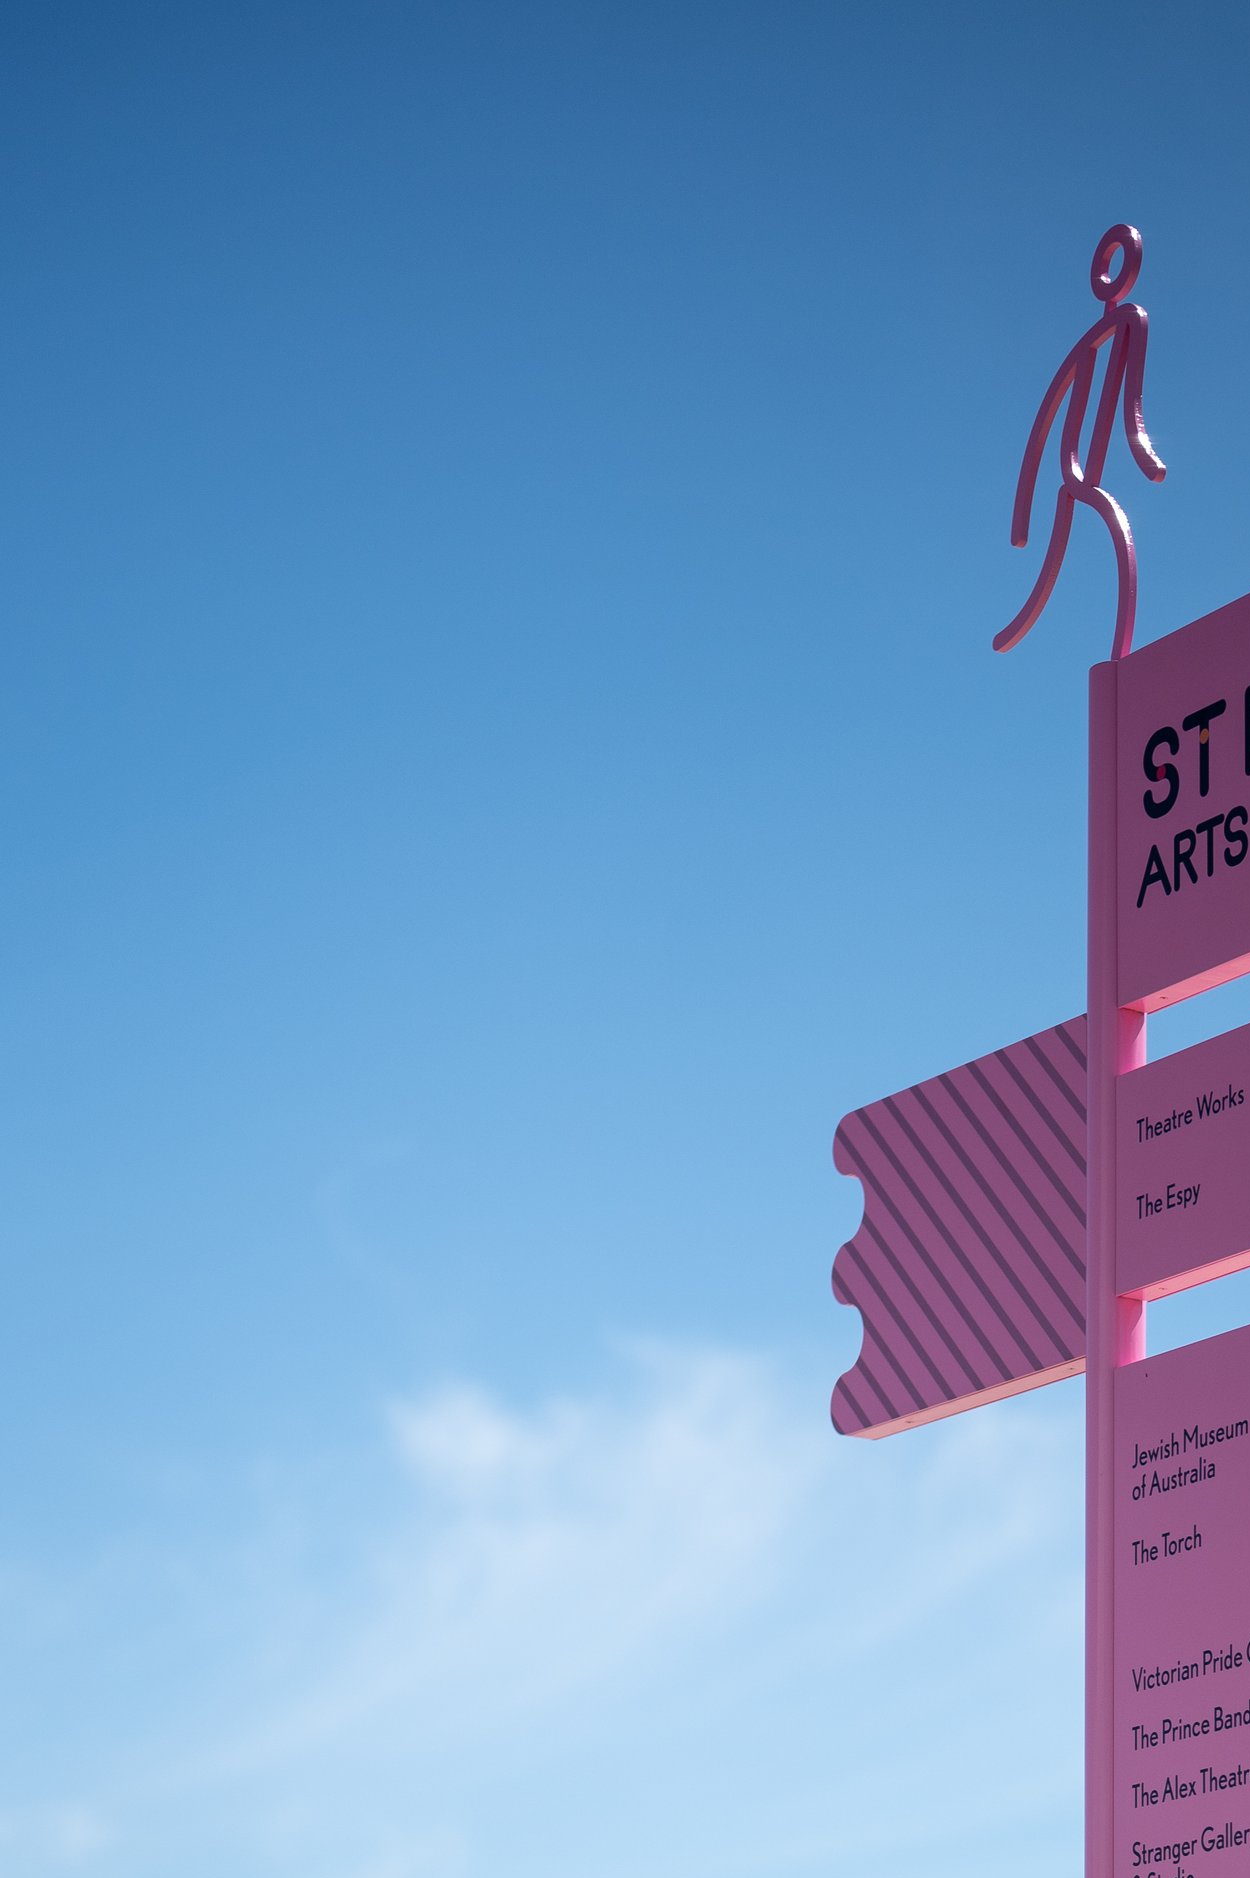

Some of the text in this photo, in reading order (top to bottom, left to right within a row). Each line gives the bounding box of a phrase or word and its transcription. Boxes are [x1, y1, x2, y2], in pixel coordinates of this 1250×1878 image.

[1142, 699, 1226, 819] ST
[1136, 806, 1248, 908] ARTS
[1136, 1084, 1244, 1143] Theatre Works
[1136, 1183, 1200, 1220] The Espy
[1132, 1417, 1248, 1468] Jewish Museum
[1132, 1457, 1216, 1501] of Australia
[1132, 1524, 1202, 1566] The Torch
[1132, 1656, 1198, 1692] Victorian
[1202, 1644, 1243, 1676] Pride
[1132, 1726, 1158, 1751] The
[1162, 1712, 1210, 1744] Prince
[1132, 1783, 1158, 1809] The
[1162, 1775, 1196, 1803] Alex
[1132, 1836, 1197, 1867] Stranger
